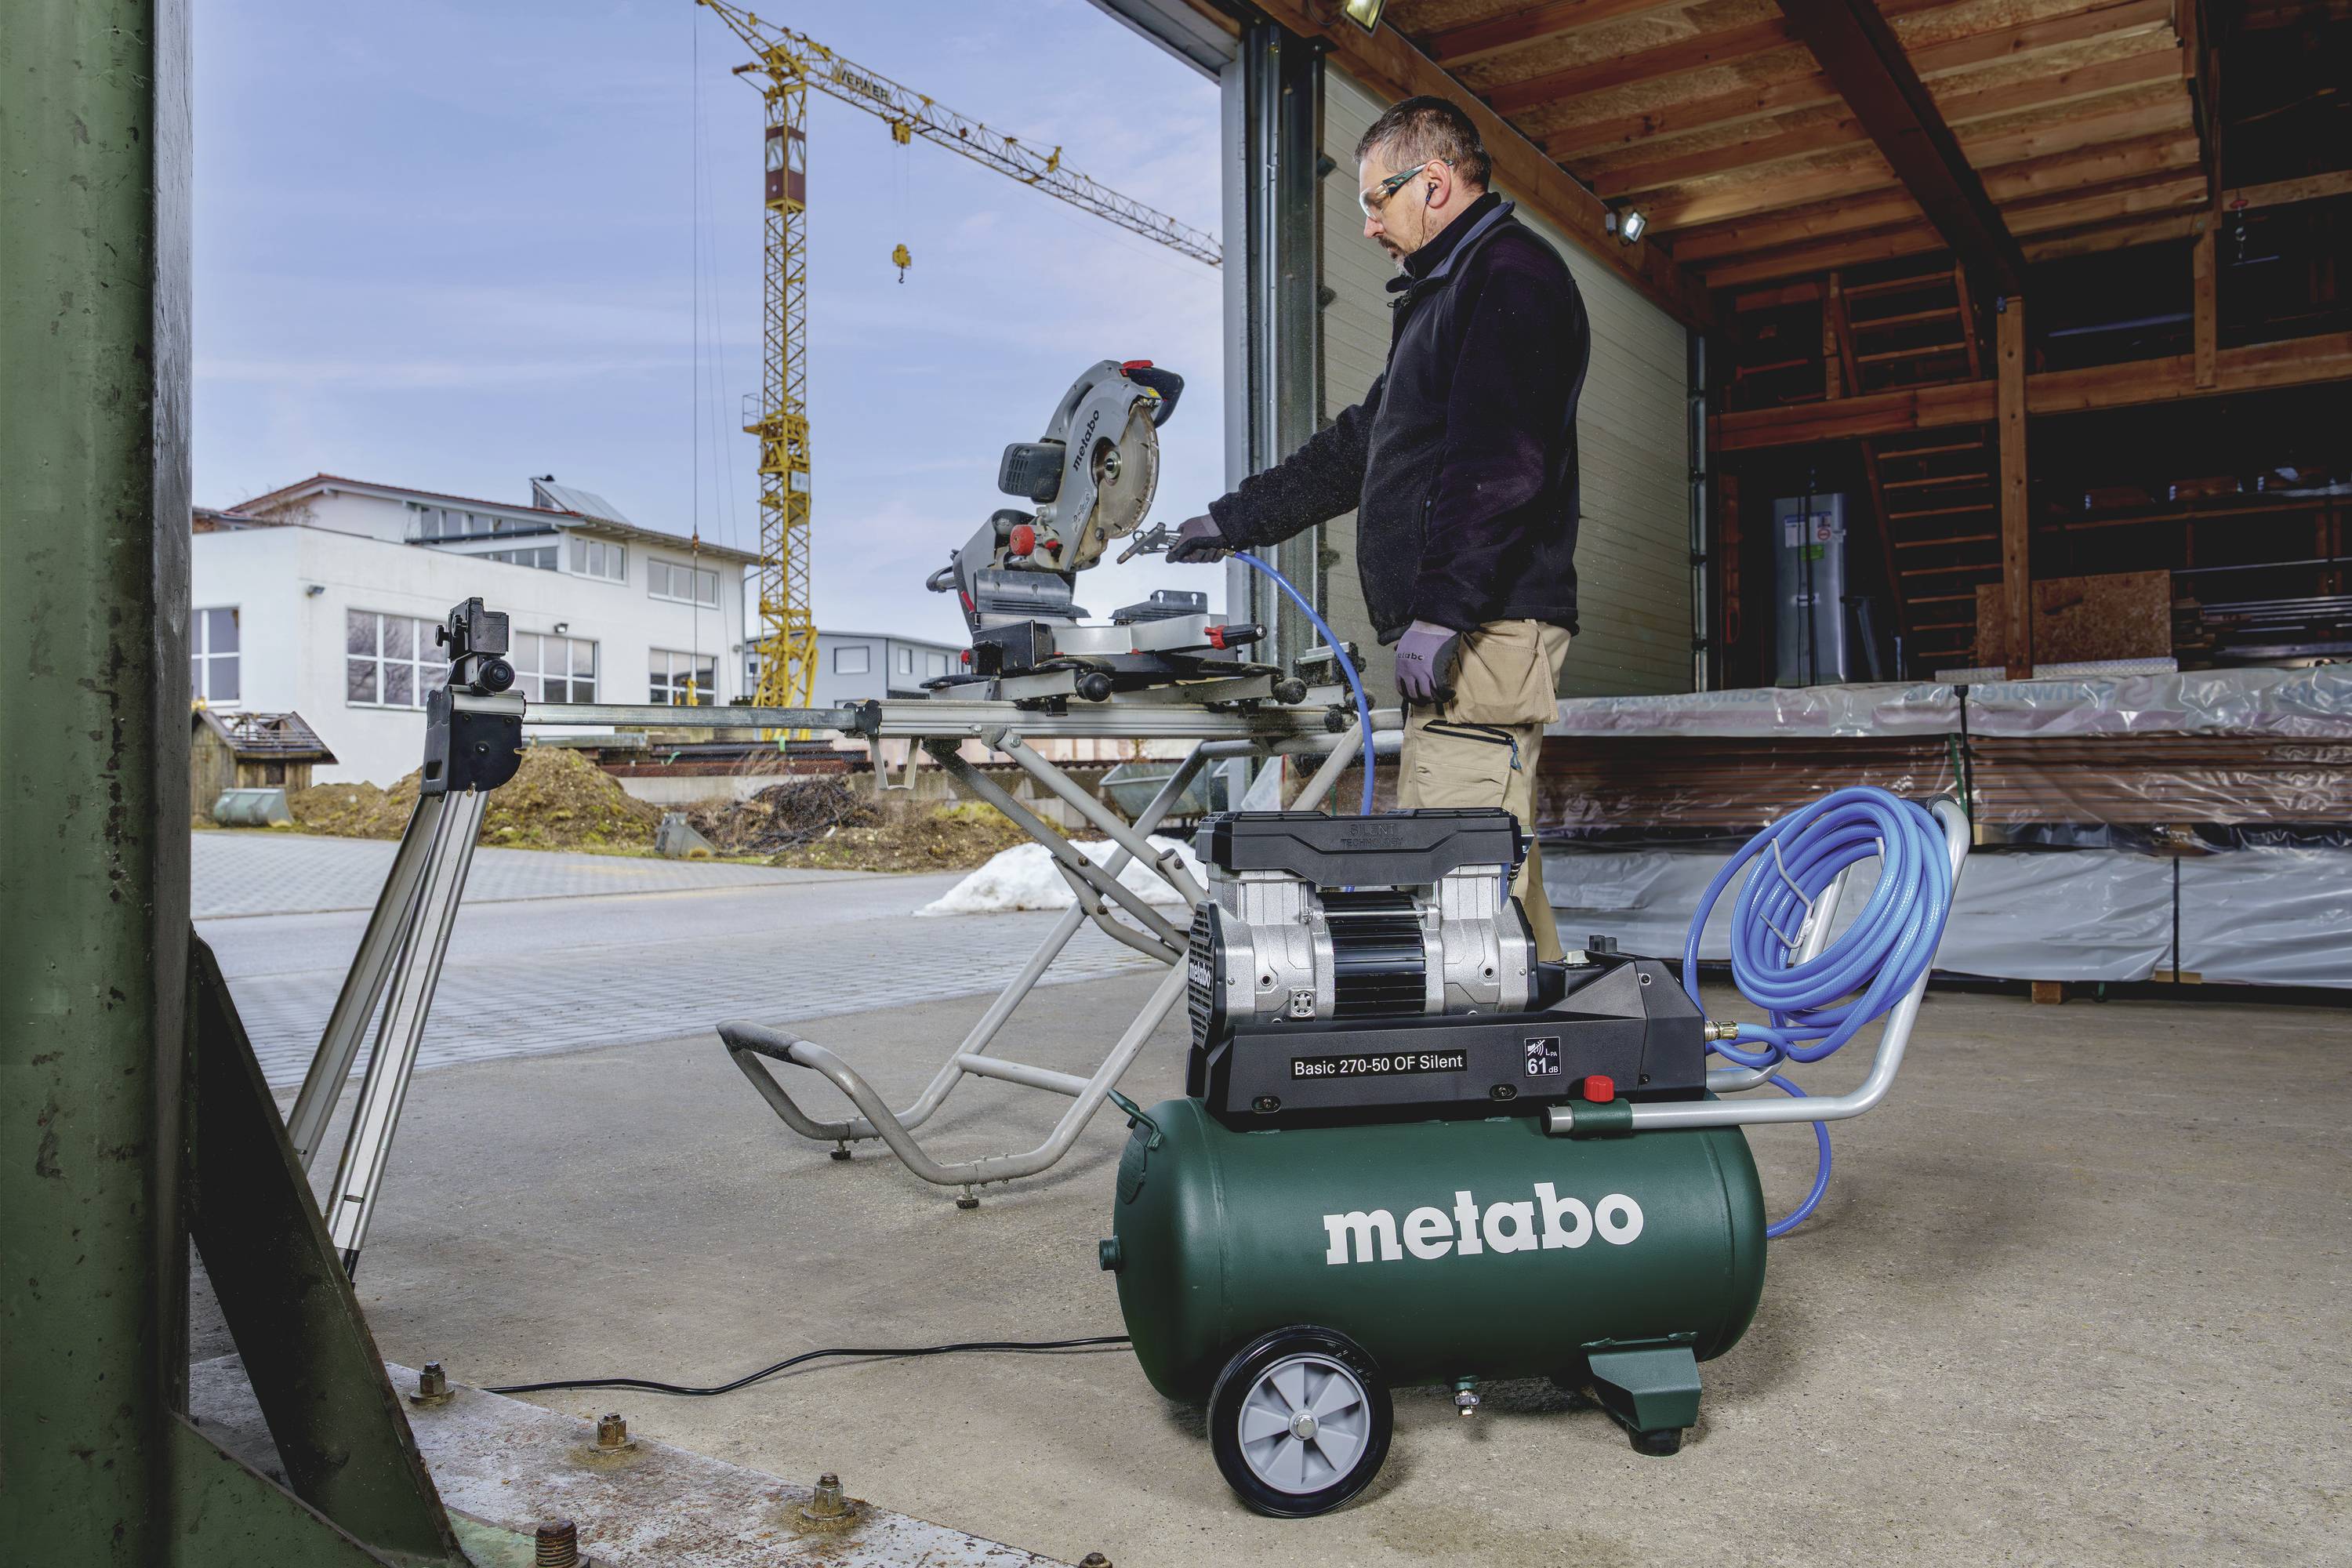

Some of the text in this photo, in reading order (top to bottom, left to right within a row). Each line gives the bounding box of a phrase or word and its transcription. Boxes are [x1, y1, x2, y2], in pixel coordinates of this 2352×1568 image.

[1073, 409, 1100, 472] metabo
[1349, 822, 1396, 836] SILENT
[1341, 837, 1403, 848] TECHNOLOGY
[1189, 961, 1210, 989] metabo
[1294, 1054, 1463, 1076] Basic 270-50 OF Silent
[1527, 1058, 1546, 1074] 61
[1323, 1182, 1644, 1265] metabo
